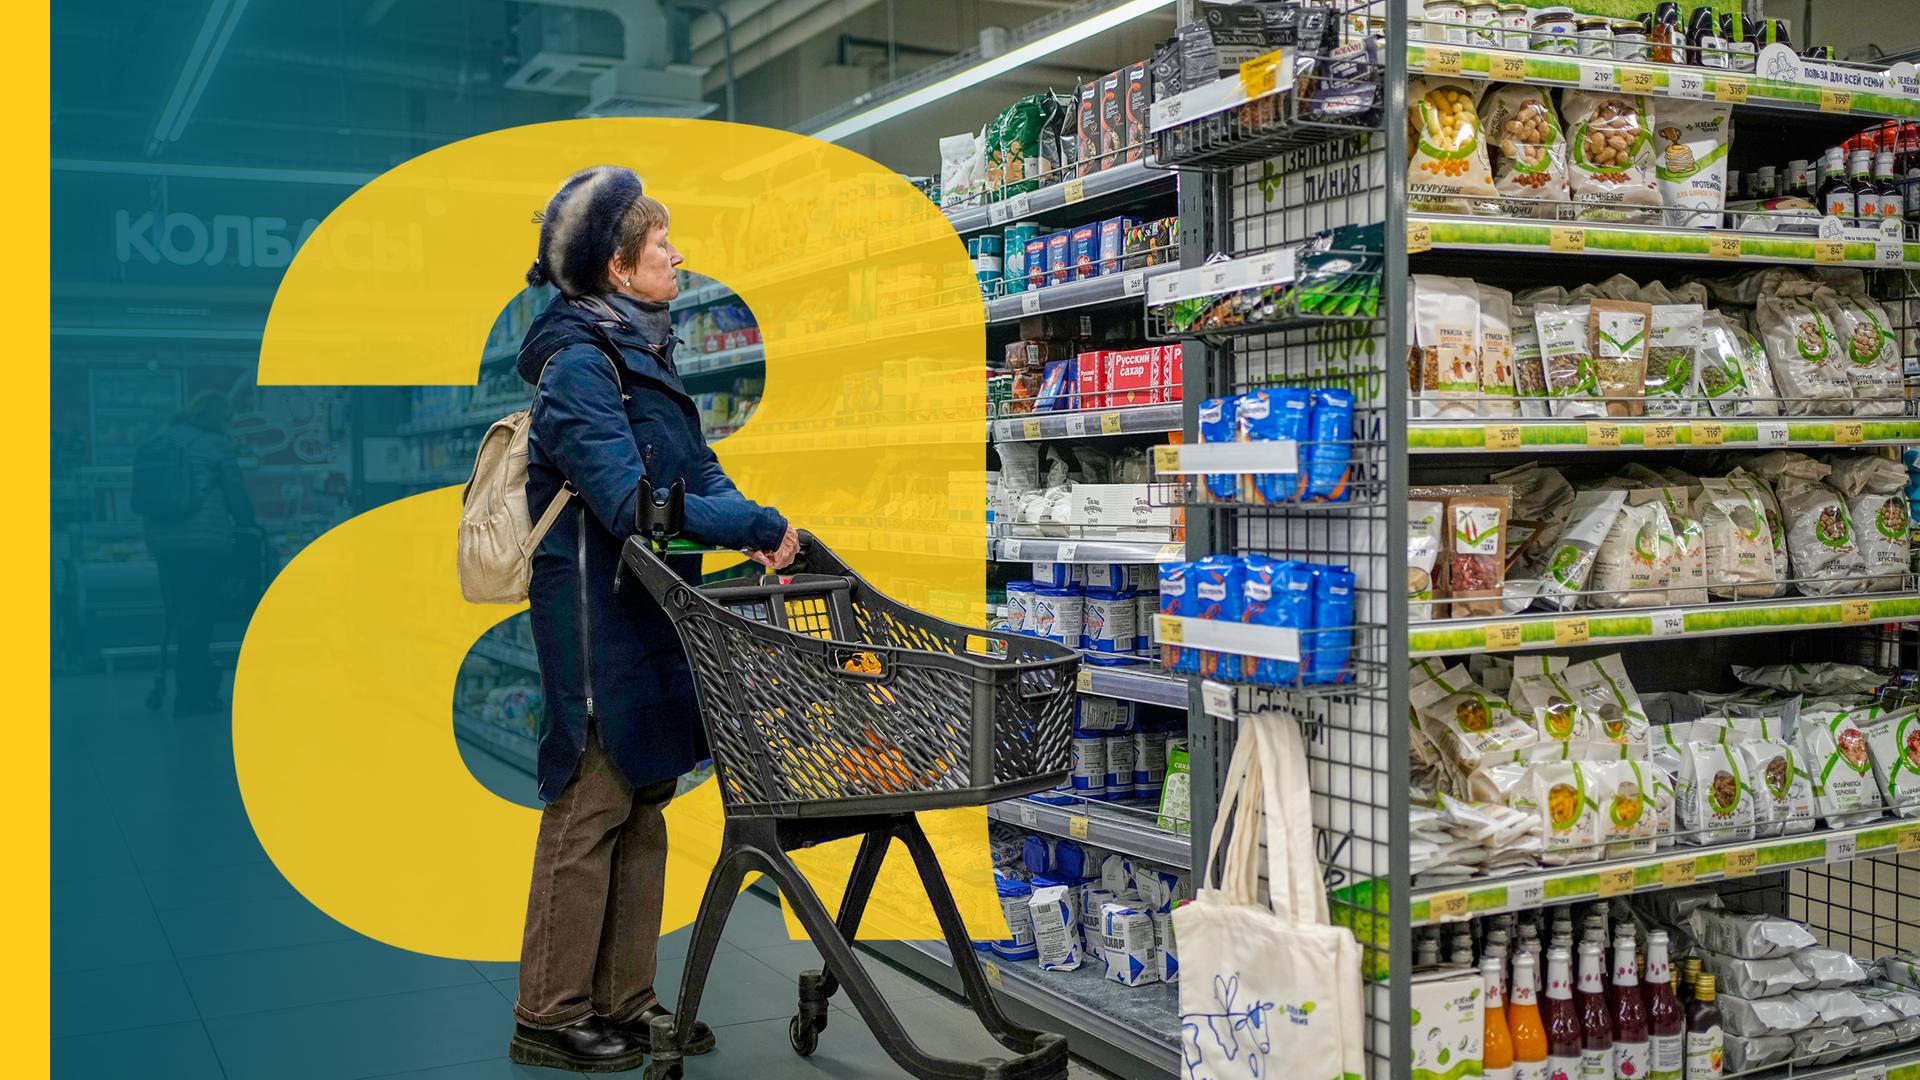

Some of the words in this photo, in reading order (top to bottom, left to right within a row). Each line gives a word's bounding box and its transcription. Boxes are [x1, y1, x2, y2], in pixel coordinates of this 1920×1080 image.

[1505, 62, 1520, 71] 279
[1594, 72, 1609, 81] 219
[1635, 76, 1650, 85] 329
[1804, 67, 1828, 81] ПОЛЬЗА
[1829, 70, 1844, 83] ДЛЯ
[1844, 72, 1862, 86] ВСЕЙ
[1863, 76, 1884, 89] СЕМЬИ
[1682, 79, 1697, 89] 379
[1730, 86, 1742, 95] 319
[1835, 96, 1847, 105] 199
[1303, 164, 1361, 203] ЛИНИЯ
[115, 208, 424, 273] КОЛБАСЫ
[1722, 240, 1737, 250] 229
[1886, 250, 1900, 259] 599
[1116, 352, 1151, 368] Русский
[1120, 365, 1145, 378] сахар
[1771, 430, 1783, 440] 179
[1664, 618, 1680, 628] 194
[1502, 630, 1517, 640] 189
